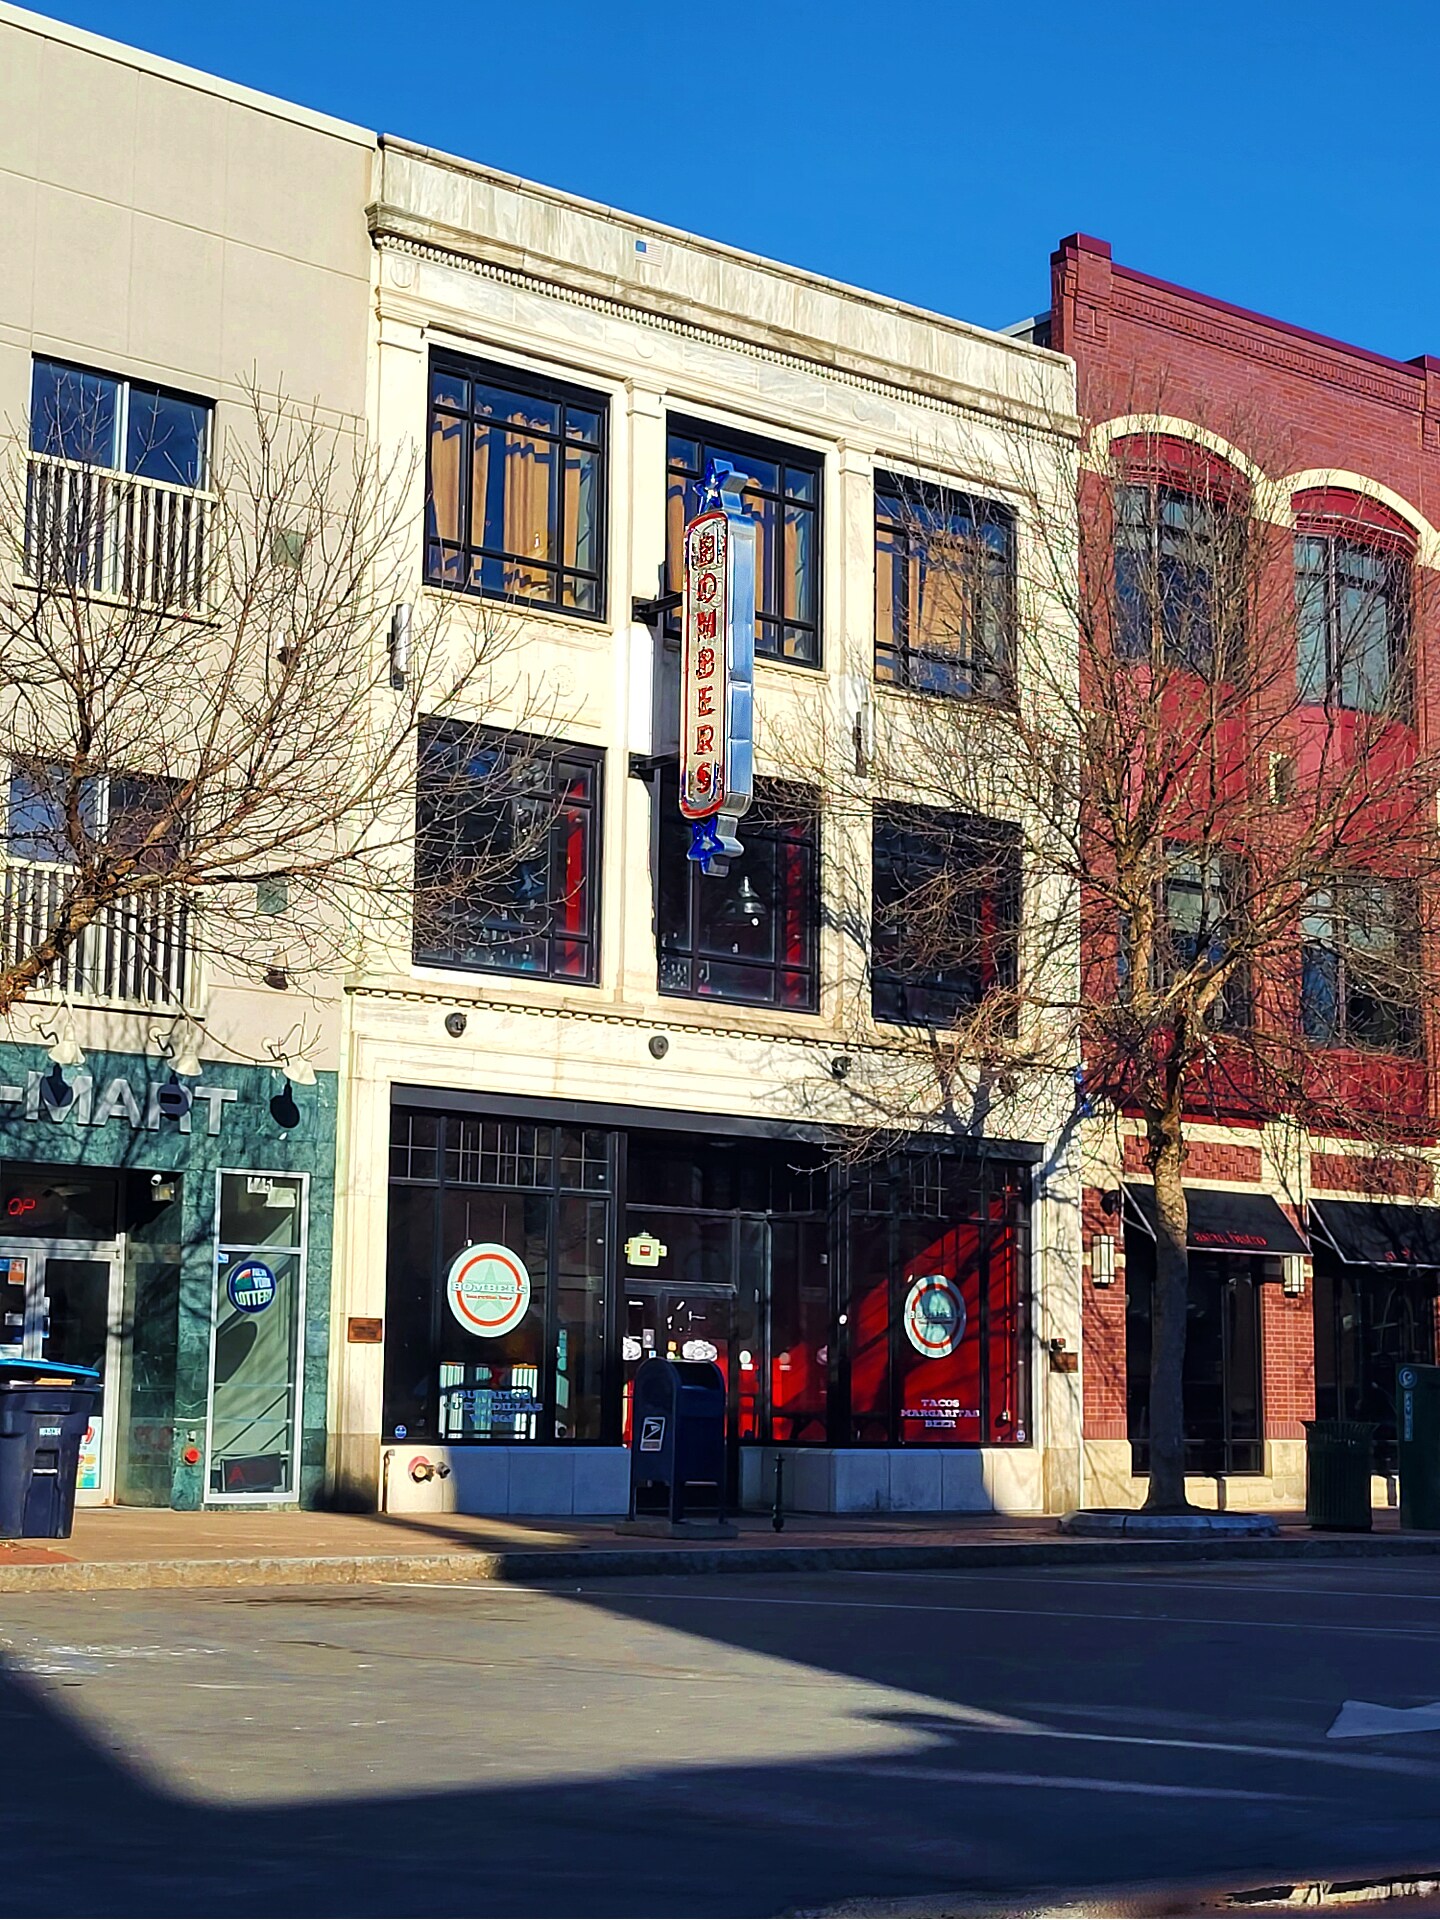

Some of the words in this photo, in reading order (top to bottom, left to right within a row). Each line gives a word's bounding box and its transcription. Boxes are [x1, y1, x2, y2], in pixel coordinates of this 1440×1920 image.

[695, 532, 717, 793] BOMBERS
[452, 1282, 527, 1294] BOMBERS
[235, 1289, 273, 1306] LOTTERY
[921, 1399, 960, 1407] TACOS
[900, 1409, 980, 1417] MARGARITAS
[925, 1420, 957, 1428] BEER
